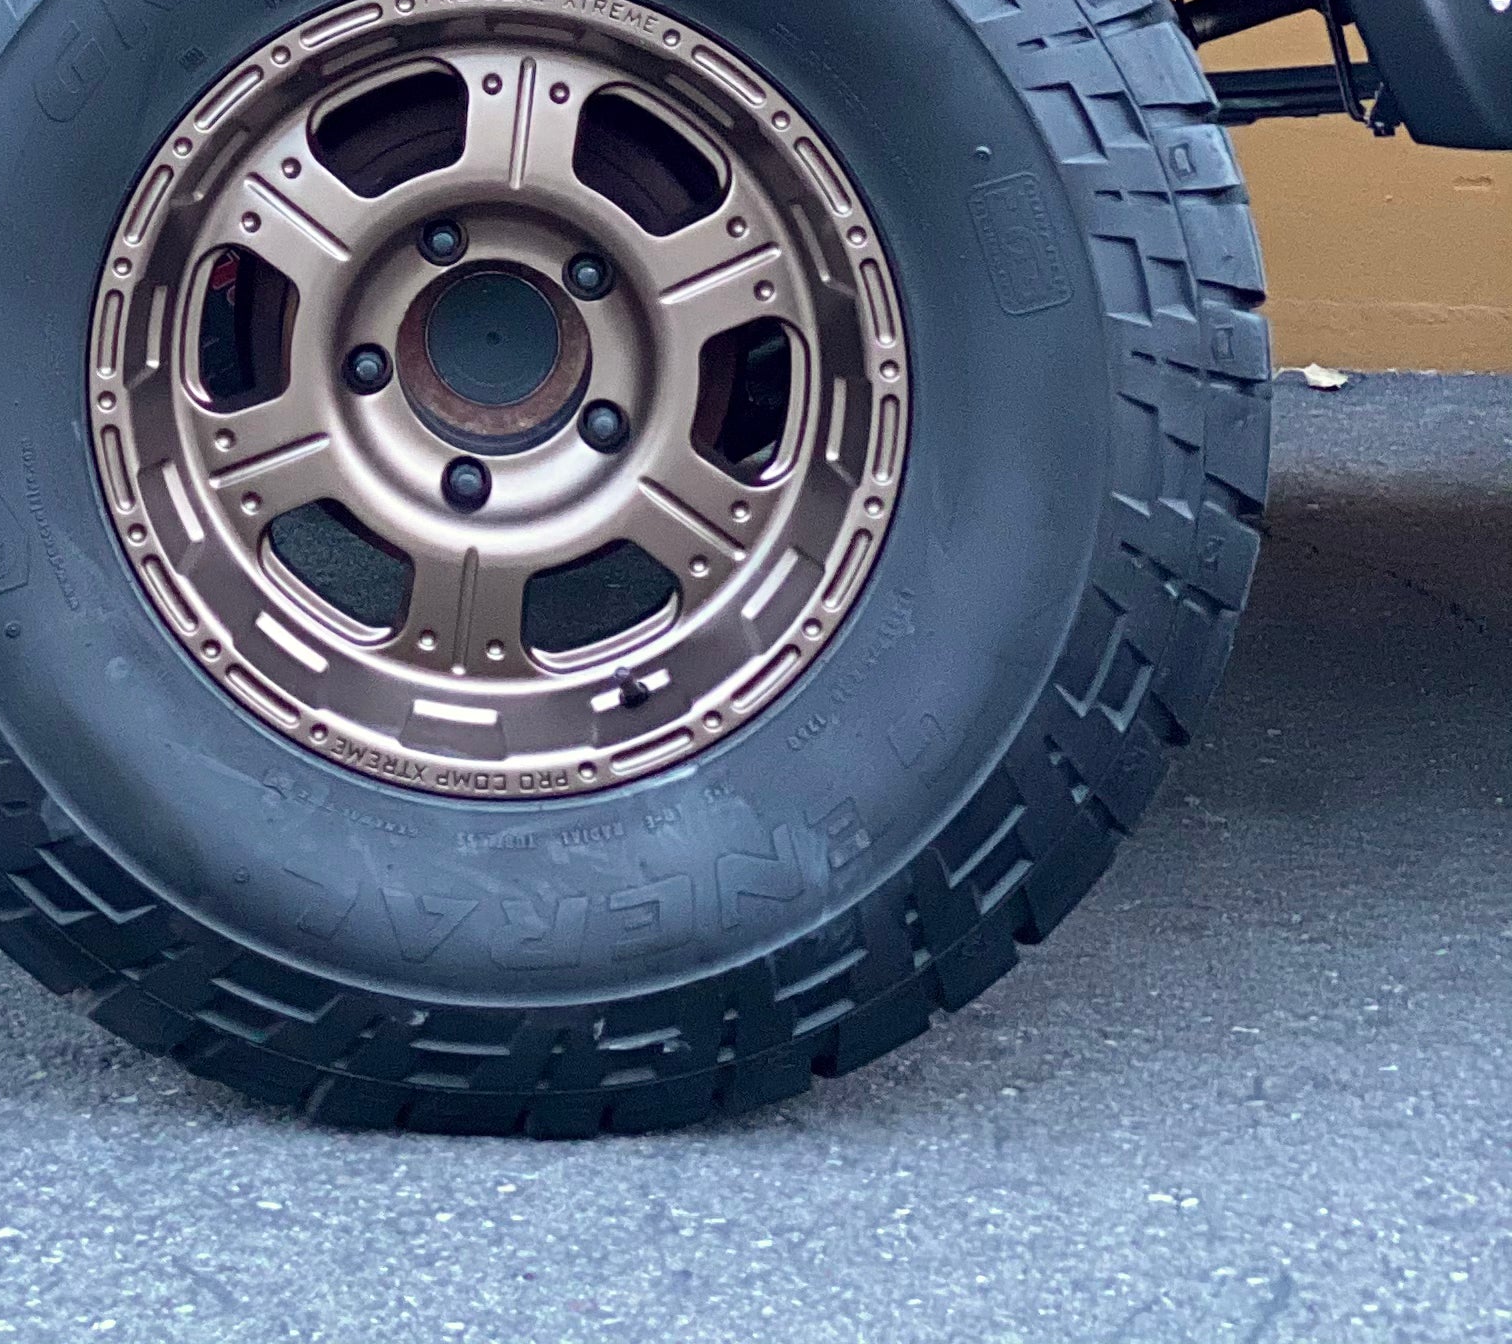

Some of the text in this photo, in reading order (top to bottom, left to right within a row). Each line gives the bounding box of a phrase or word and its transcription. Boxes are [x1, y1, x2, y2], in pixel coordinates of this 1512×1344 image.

[331, 737, 569, 792] PRO COMP XTREME
